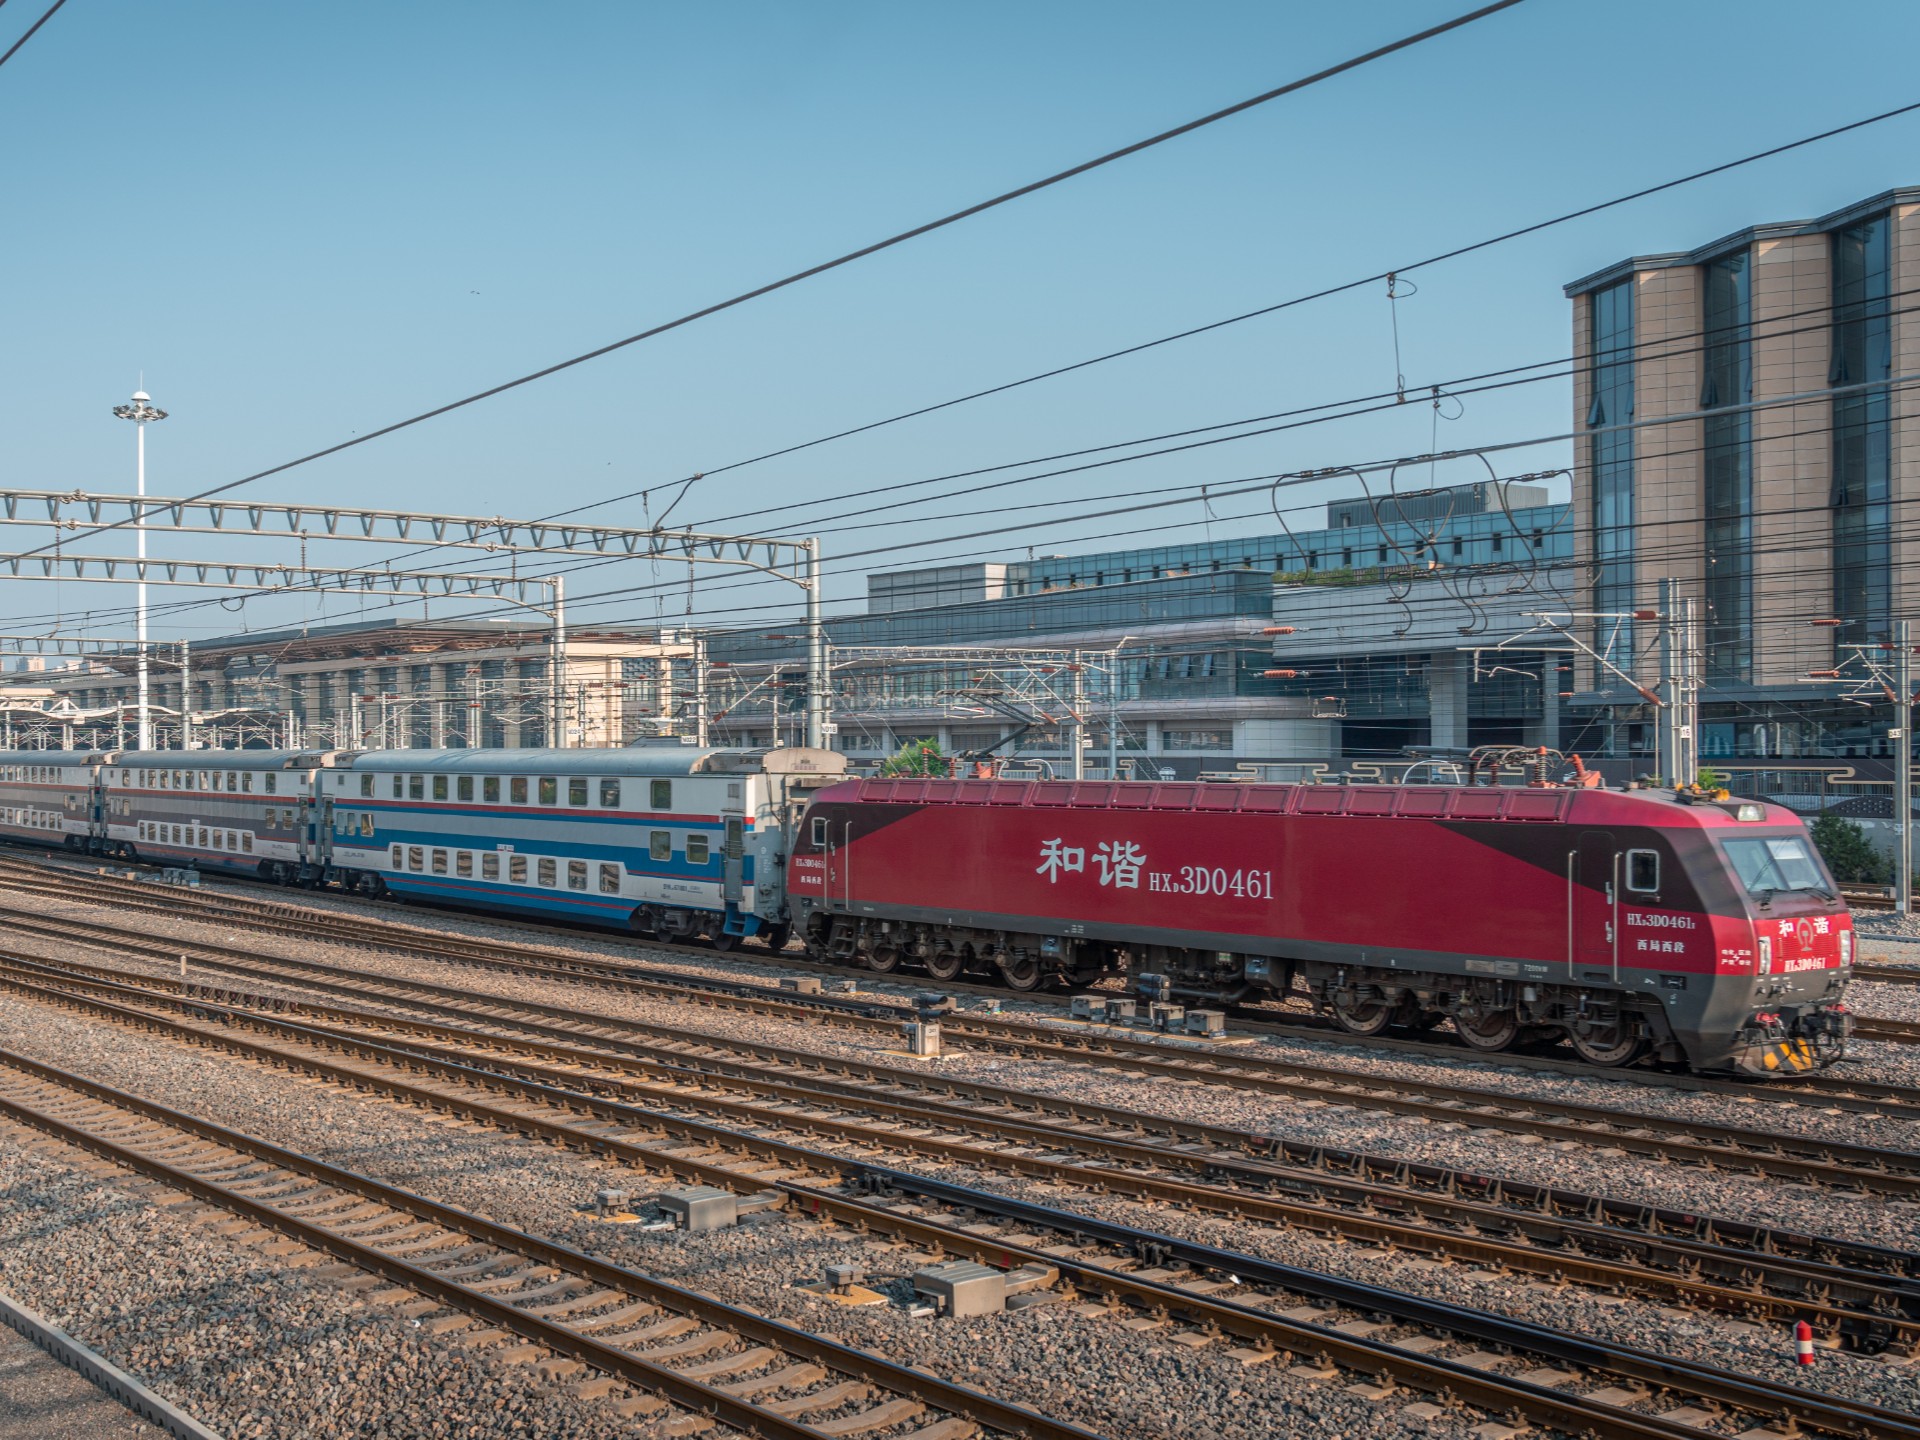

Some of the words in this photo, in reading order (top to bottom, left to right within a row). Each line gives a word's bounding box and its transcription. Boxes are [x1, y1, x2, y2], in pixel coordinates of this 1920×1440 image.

[1036, 838, 1147, 889] 和谐
[1637, 939, 1685, 954] 西局西段
